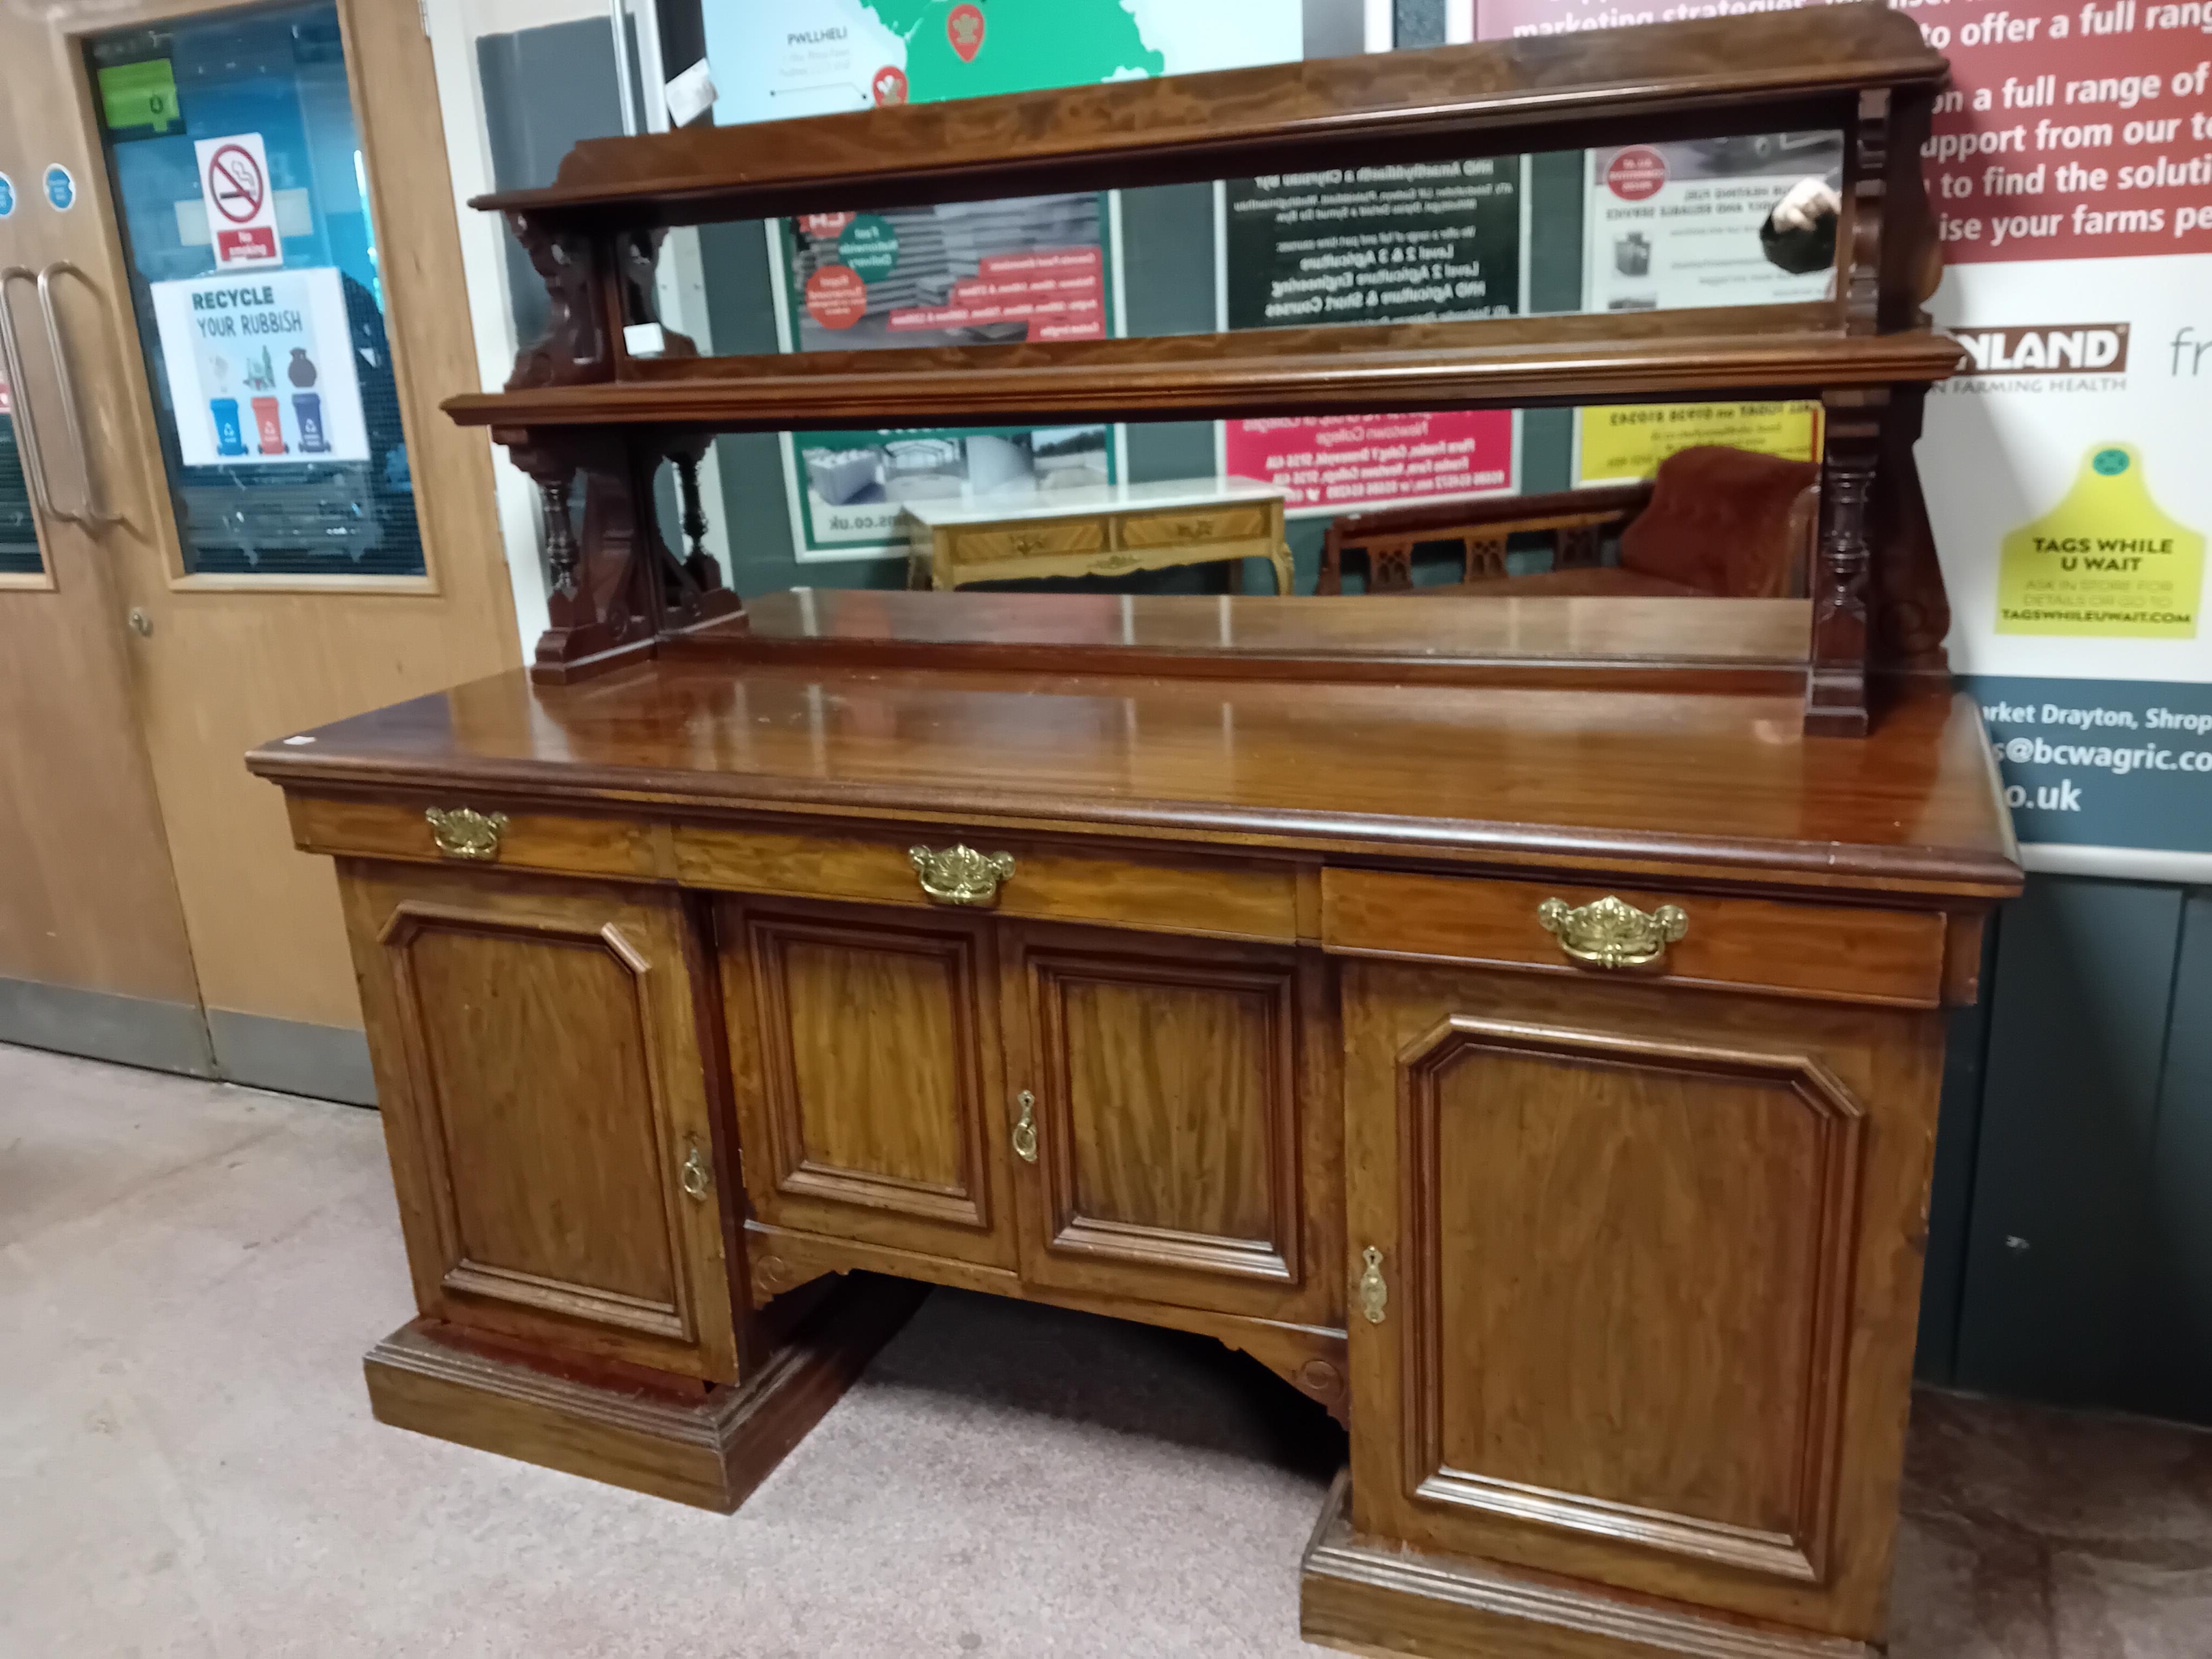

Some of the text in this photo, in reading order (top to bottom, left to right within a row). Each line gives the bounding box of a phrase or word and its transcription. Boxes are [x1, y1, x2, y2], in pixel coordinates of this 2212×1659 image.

[1960, 11, 2041, 47] offer
[2048, 15, 2070, 39] a
[2079, 0, 2136, 35] full
[1972, 88, 1992, 112] a
[2002, 74, 2055, 109] full
[2065, 74, 2161, 110] range
[2171, 61, 2210, 97] of
[2035, 119, 2112, 150] from
[2123, 118, 2182, 146] our
[1940, 171, 1973, 200] to
[1982, 163, 2047, 197] find
[2055, 161, 2108, 194] the
[1990, 211, 2063, 247] your
[2071, 204, 2165, 236] farms
[192, 285, 275, 311] RECYCLE
[197, 310, 303, 338] YOUR RUBBISH
[1953, 378, 2044, 395] FARMING
[2049, 377, 2127, 392] HEALTH
[2032, 537, 2174, 554] TAGS WHILE
[2061, 557, 2143, 571] U WAIT
[2026, 580, 2174, 590] ASK IN STORE FOR
[2023, 594, 2085, 607] DETAILS
[2088, 595, 2114, 607] OR
[2001, 608, 2191, 624] TAGSWHILEUWAIT.COM
[2041, 703, 2139, 730] Drayton,
[2144, 708, 2212, 735] Shrop
[2005, 779, 2082, 812] o.uk
